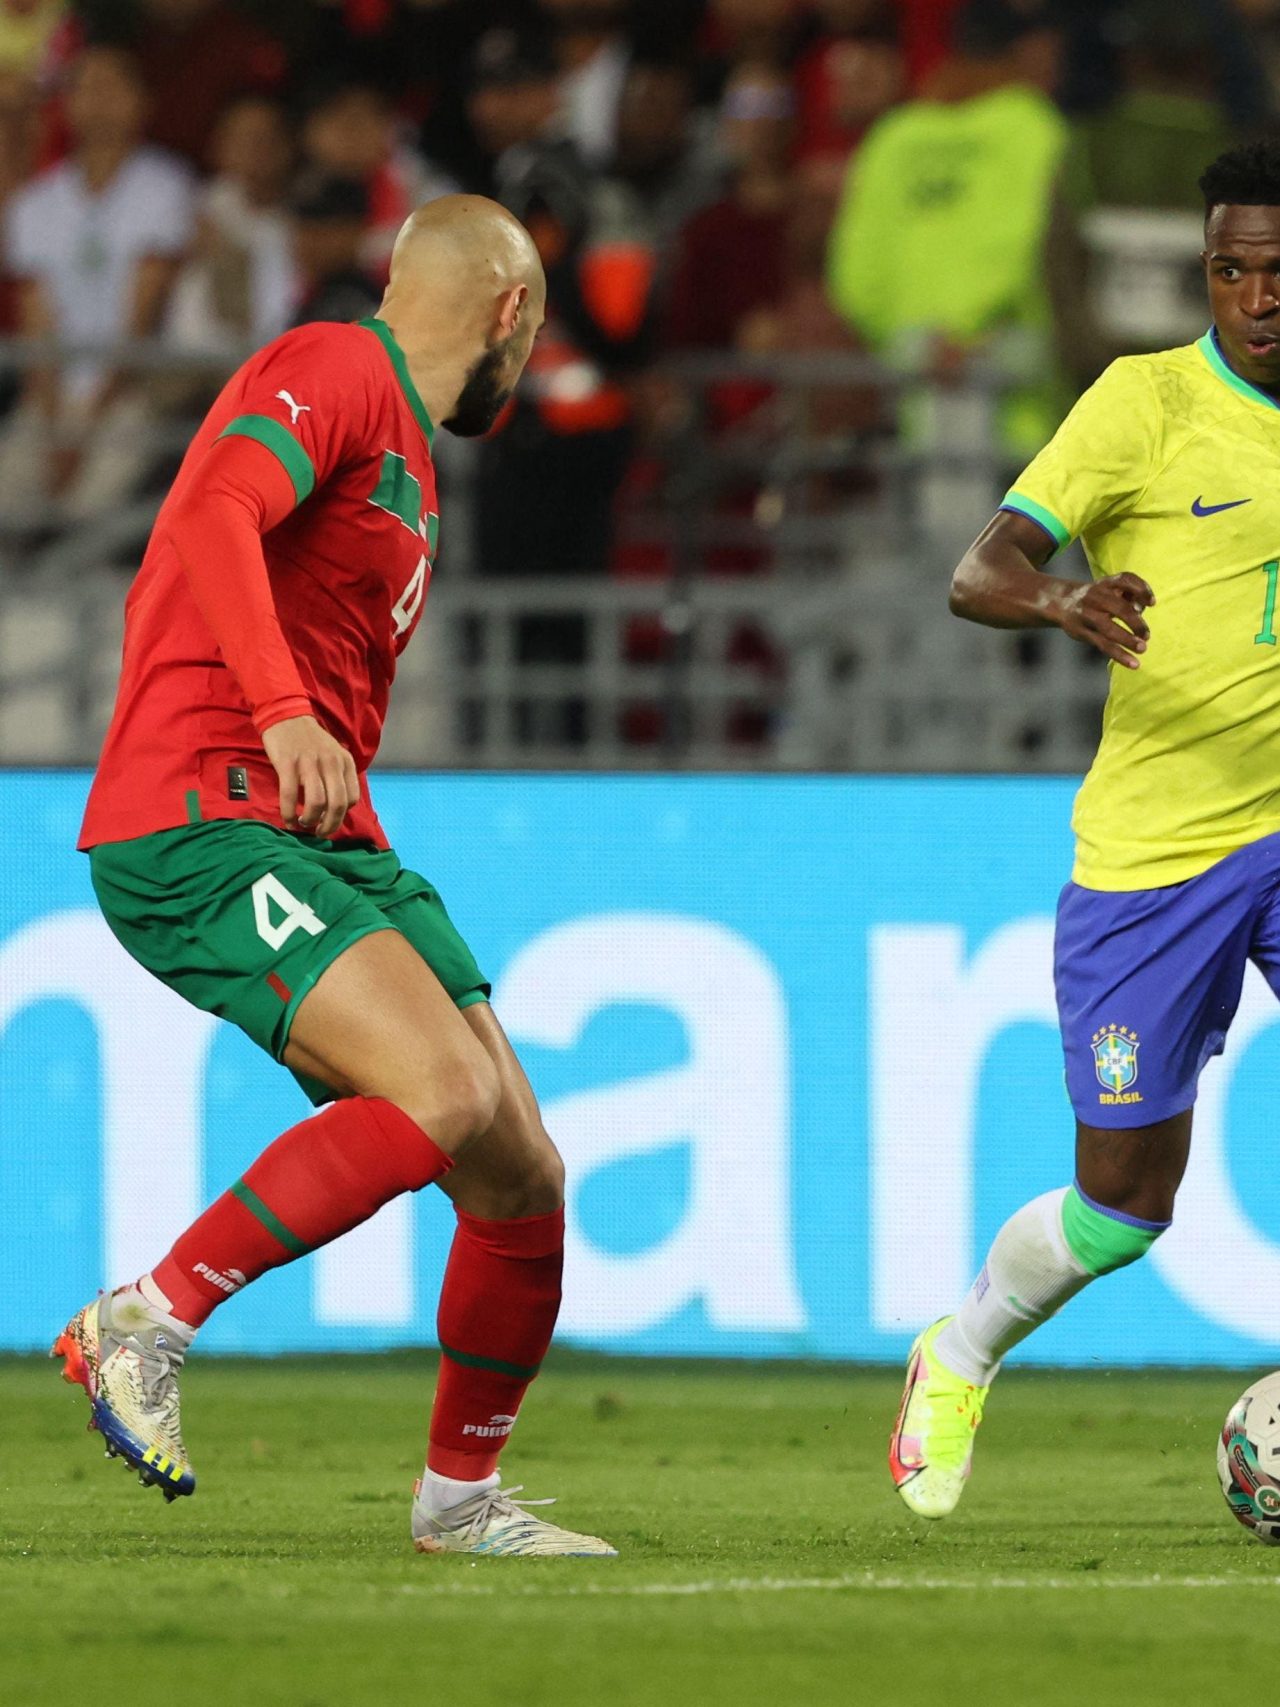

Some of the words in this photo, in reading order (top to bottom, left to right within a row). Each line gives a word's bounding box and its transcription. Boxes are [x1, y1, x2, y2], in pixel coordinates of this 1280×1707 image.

[391, 554, 427, 640] 4
[251, 872, 328, 952] 4
[1099, 1091, 1144, 1105] BRASIL
